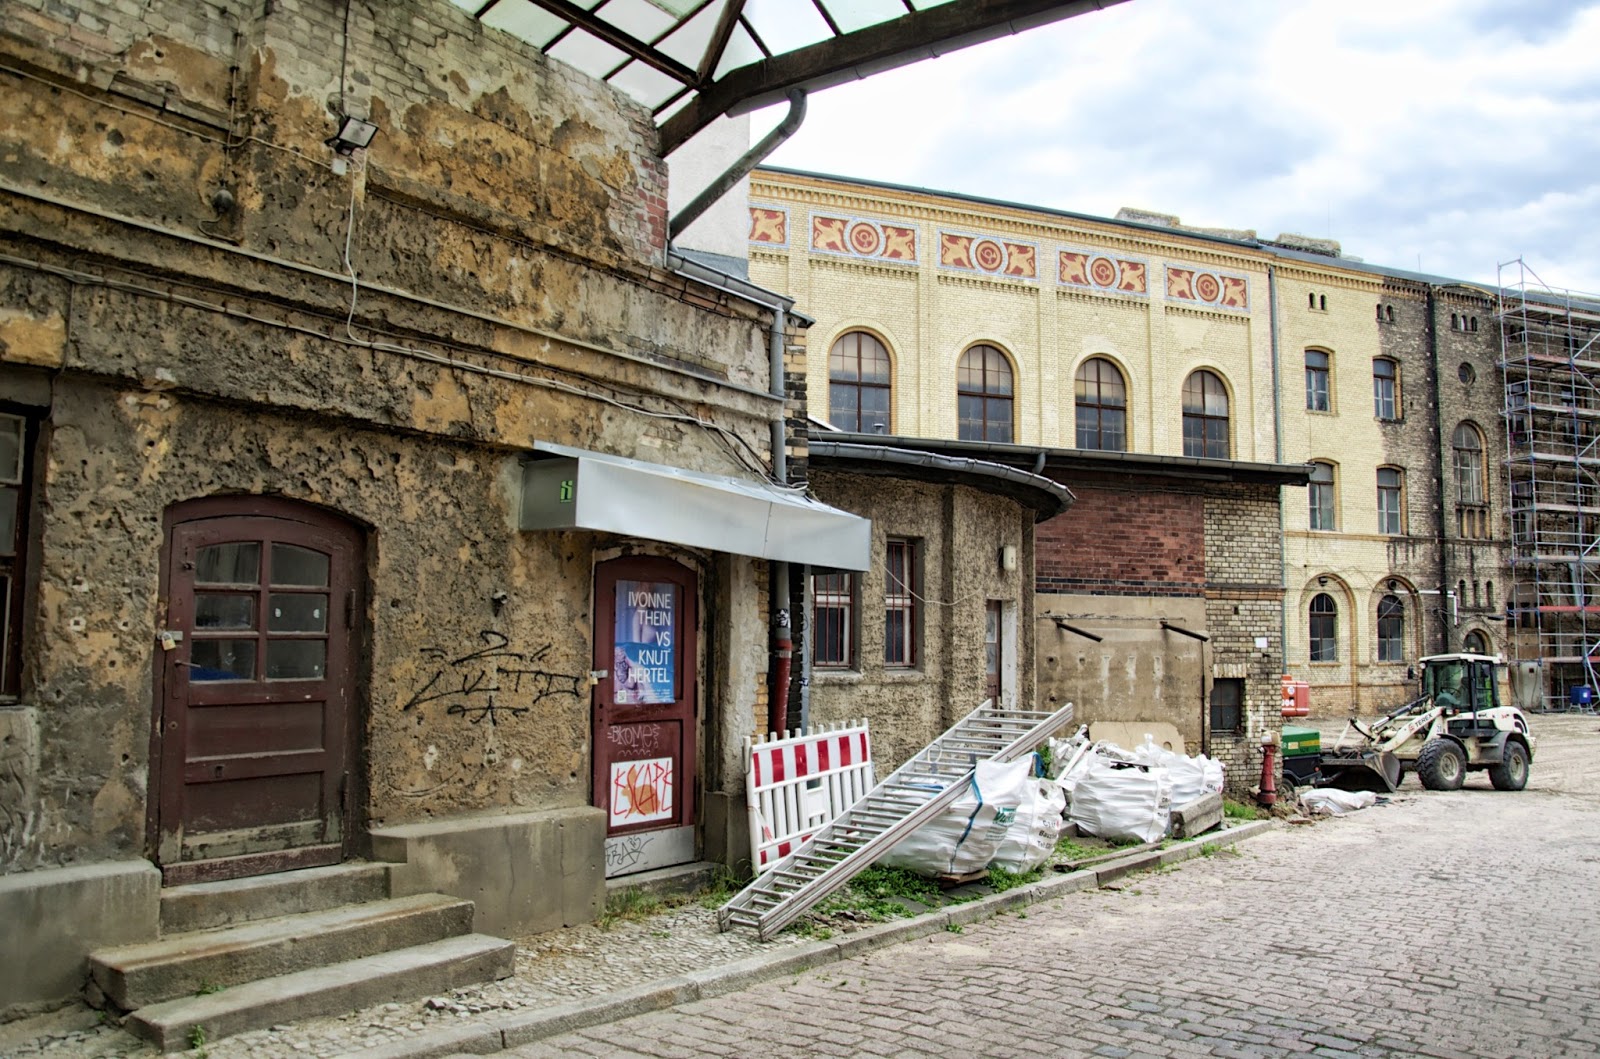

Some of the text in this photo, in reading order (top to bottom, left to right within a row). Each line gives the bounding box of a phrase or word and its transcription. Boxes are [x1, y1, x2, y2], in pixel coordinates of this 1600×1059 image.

[628, 591, 671, 609] IVONNE
[637, 609, 671, 626] THEIN
[655, 631, 671, 647] VS
[638, 649, 671, 665] KNUT
[628, 667, 670, 683] HERTEL
[1414, 713, 1433, 727] TEREX
